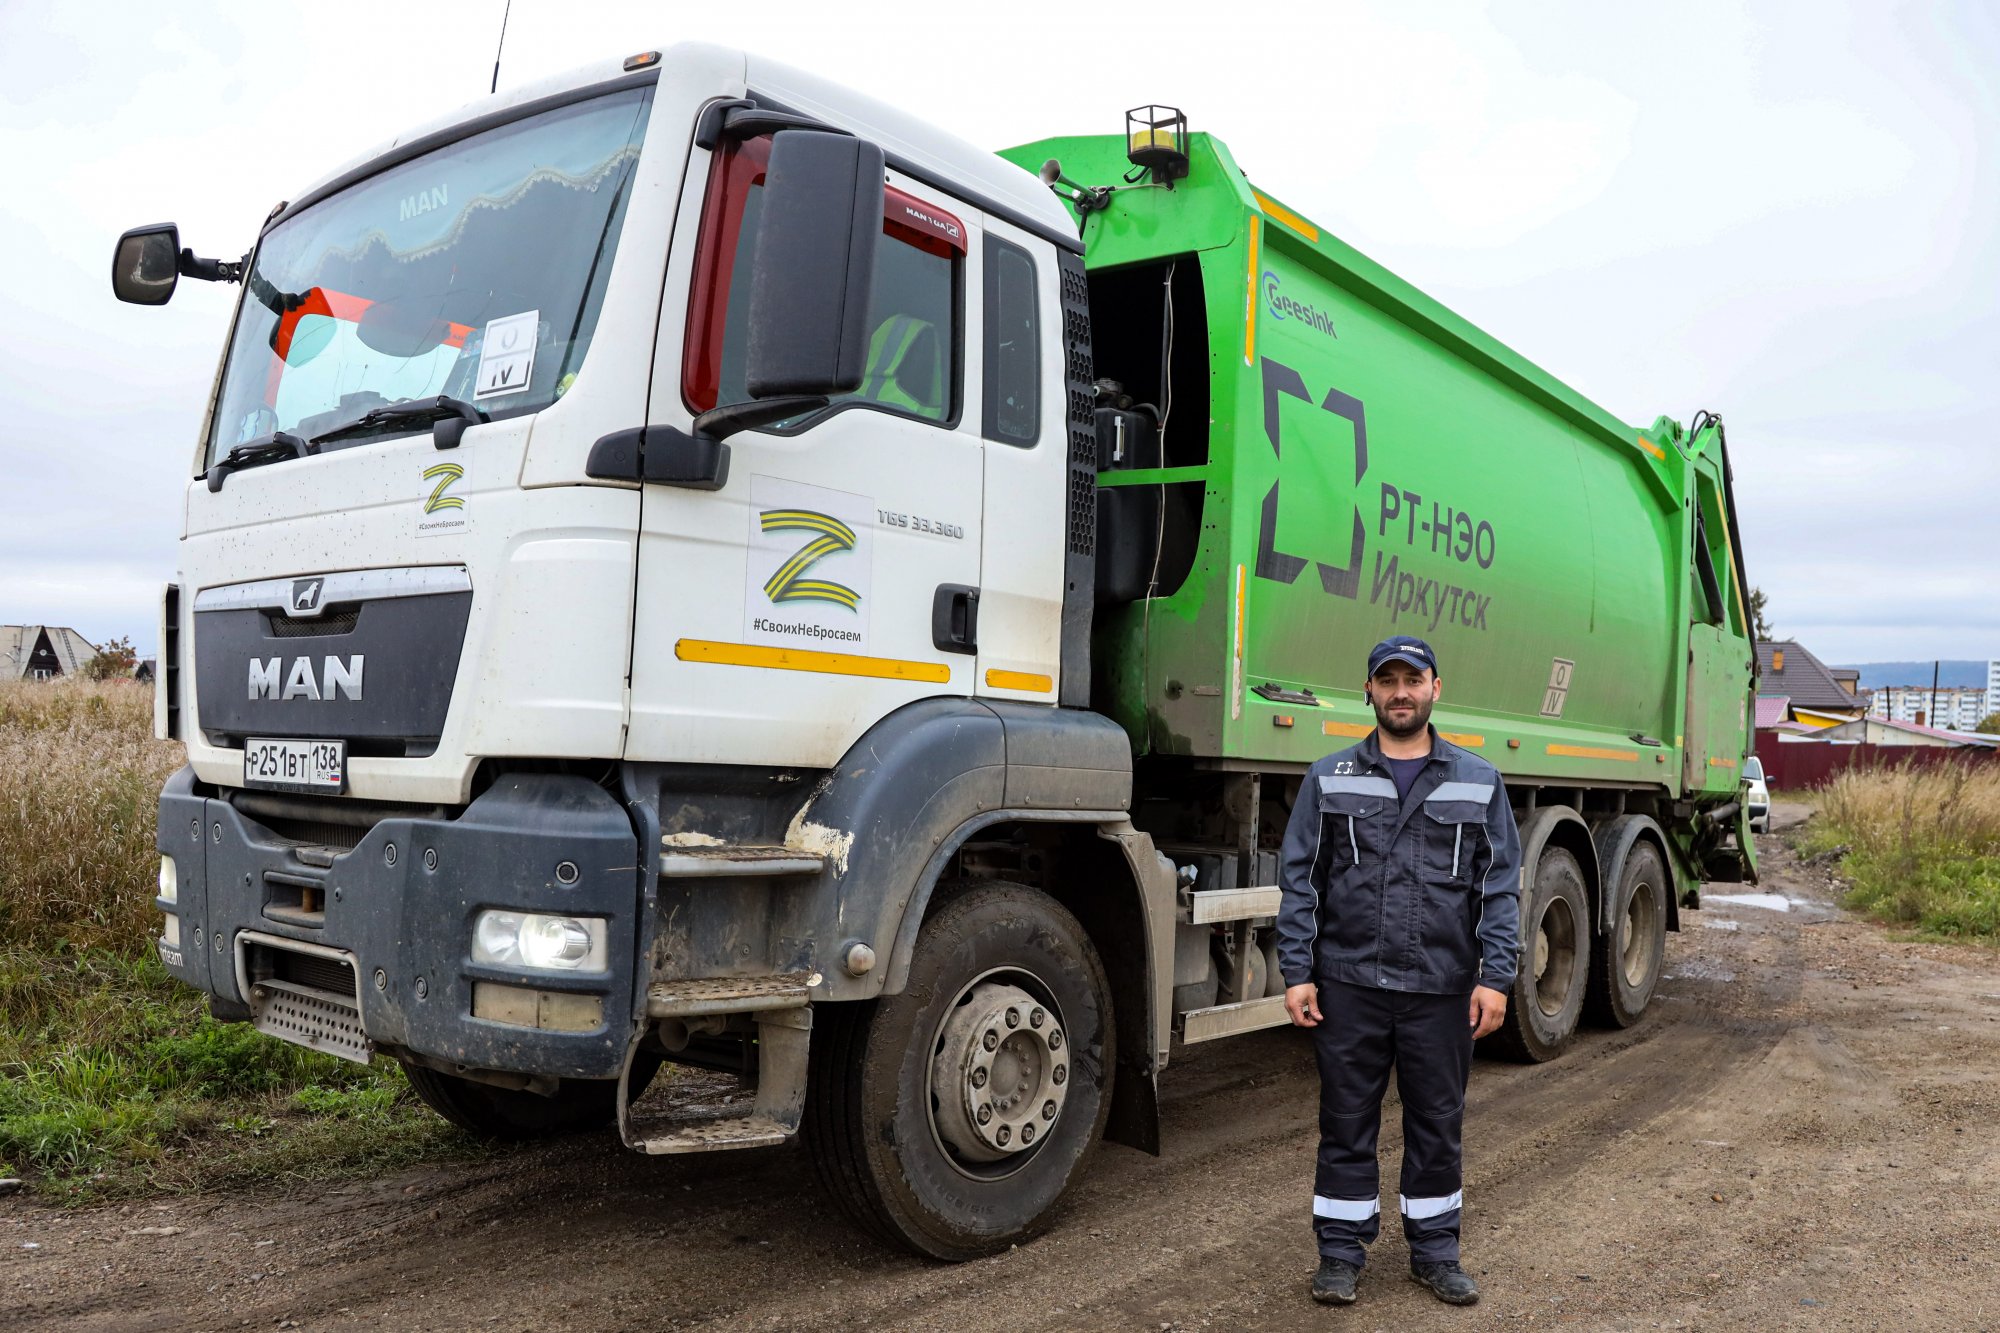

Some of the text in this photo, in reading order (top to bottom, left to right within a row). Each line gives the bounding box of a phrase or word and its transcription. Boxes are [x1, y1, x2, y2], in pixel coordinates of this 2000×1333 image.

[400, 183, 448, 222] MAN
[905, 206, 927, 222] MAN
[1263, 271, 1338, 340] Geesink
[419, 519, 465, 531] #СвоихНеБросаем
[877, 508, 964, 540] TGS 33.360
[1379, 481, 1496, 570] РТ-НЭО
[1369, 550, 1492, 633] Иркутск
[753, 617, 862, 643] #СвоихНеБросаем
[247, 654, 365, 701] MAN
[312, 744, 338, 771] 138
[316, 770, 330, 781] RUS
